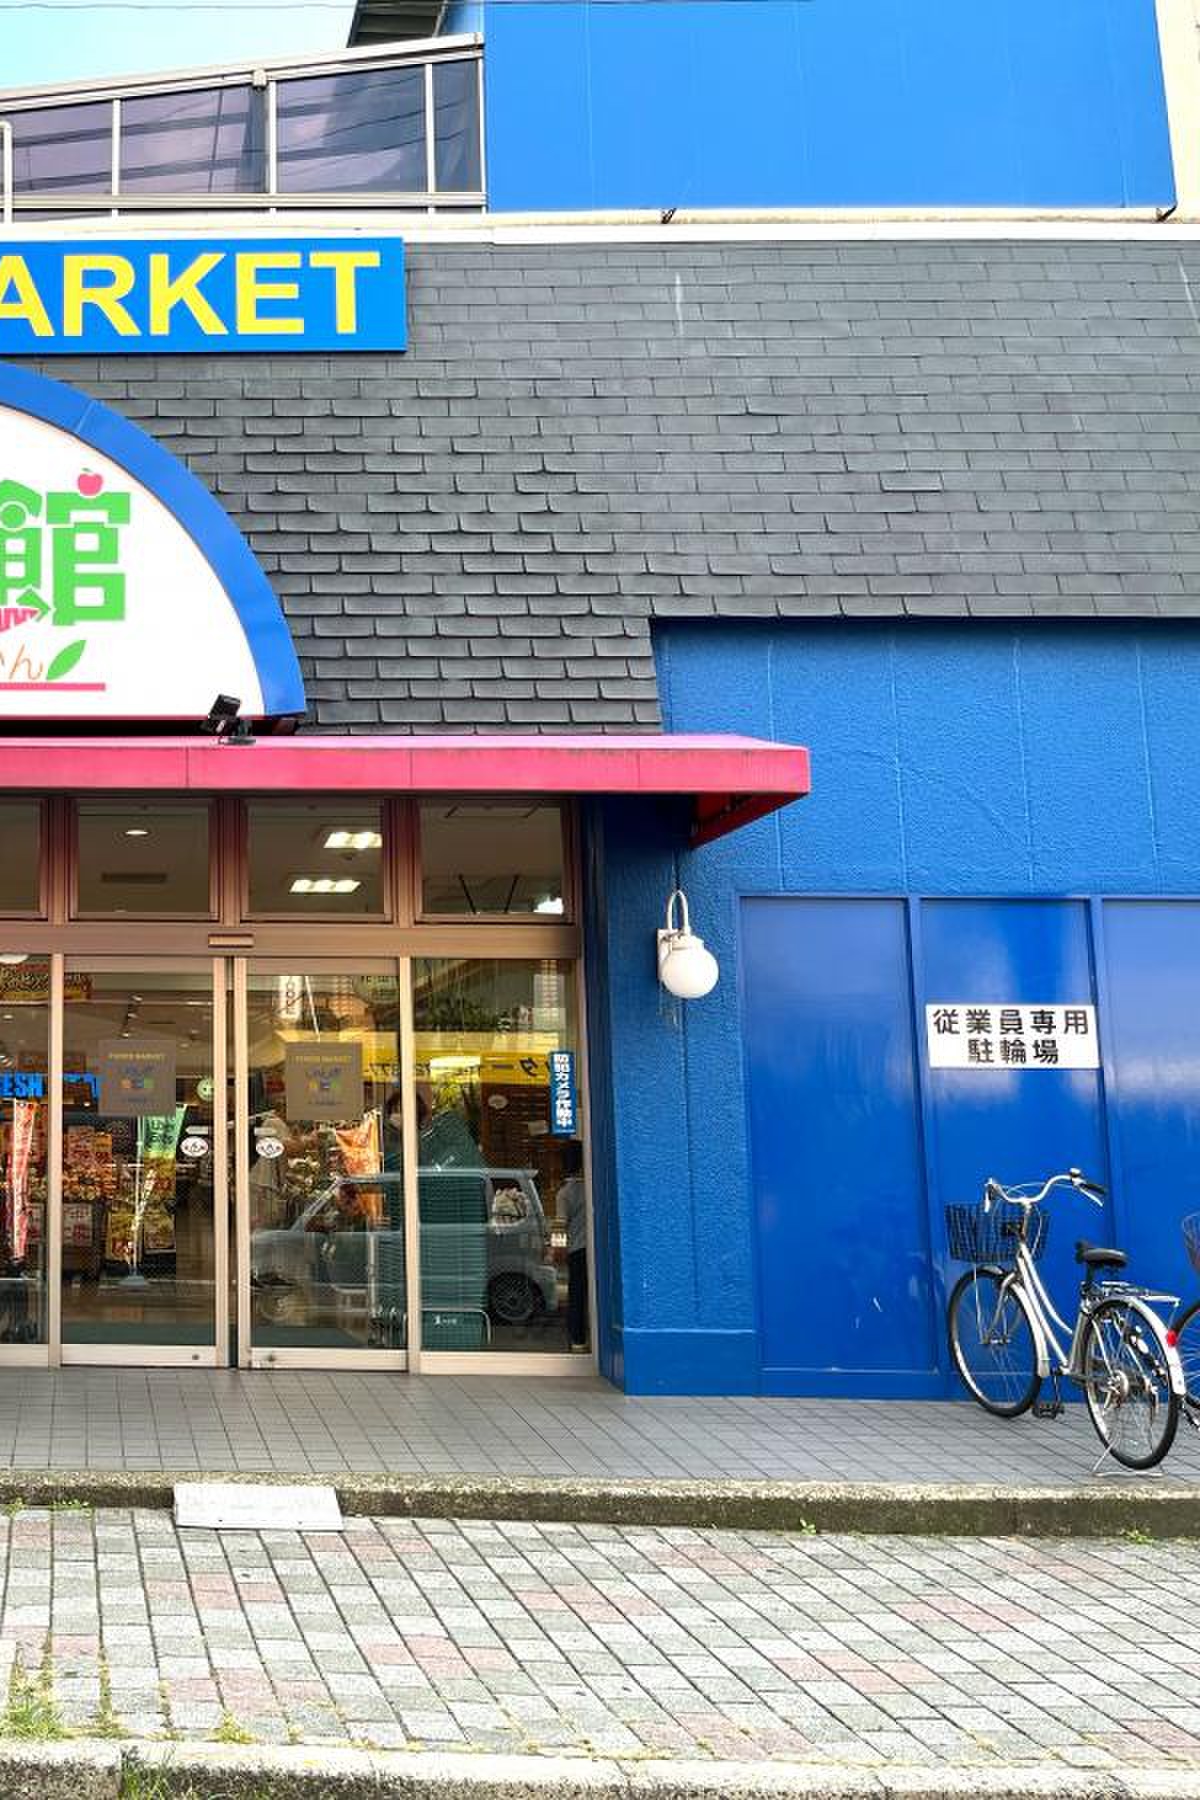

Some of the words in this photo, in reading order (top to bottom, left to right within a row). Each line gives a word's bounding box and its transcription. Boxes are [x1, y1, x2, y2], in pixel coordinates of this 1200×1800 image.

[933, 1008, 1089, 1035] 従業員専用
[968, 1038, 1059, 1064] 駐輪場
